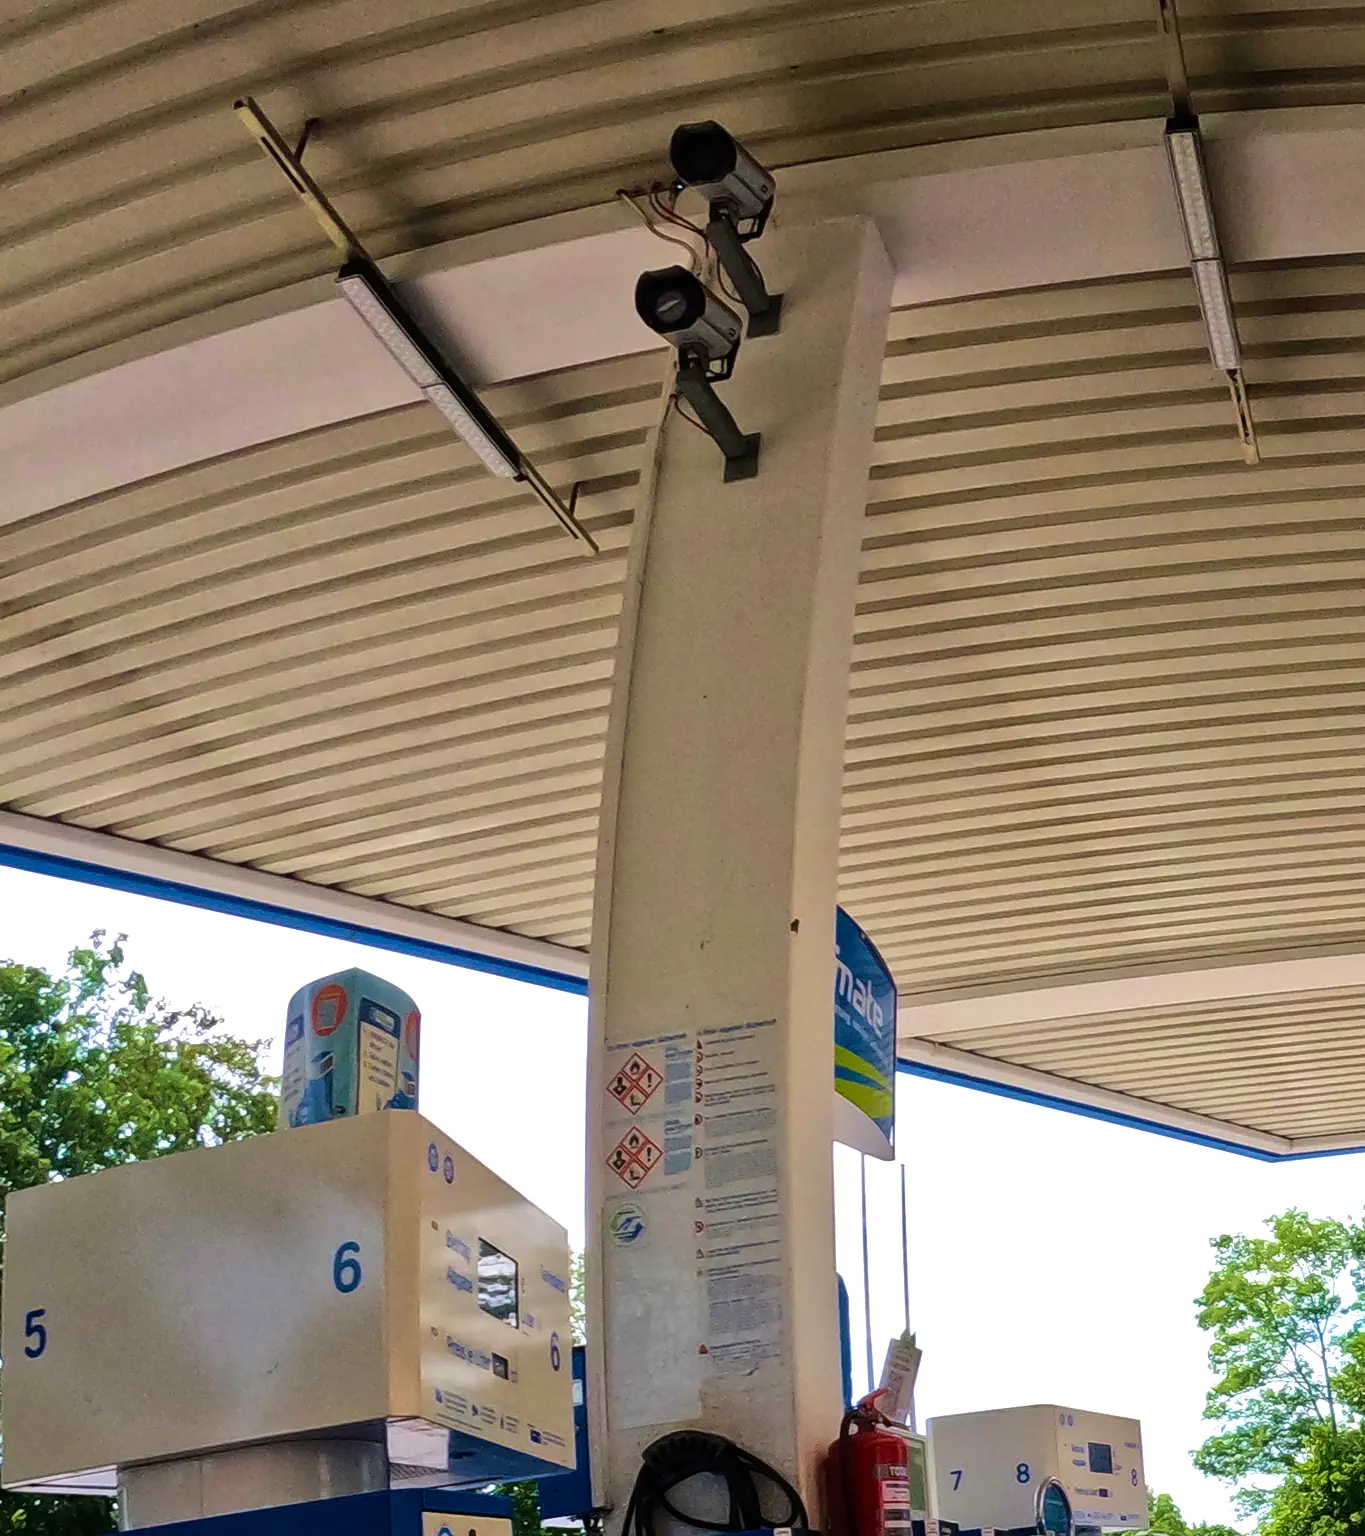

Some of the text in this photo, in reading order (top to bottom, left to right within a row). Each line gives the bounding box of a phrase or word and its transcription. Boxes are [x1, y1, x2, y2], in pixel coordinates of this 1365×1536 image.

[332, 1242, 362, 1293] 6
[24, 1308, 47, 1359] 5
[550, 1331, 561, 1372] 6
[950, 1470, 963, 1491] 7
[1016, 1462, 1030, 1484] 8
[1131, 1468, 1138, 1487] 8
